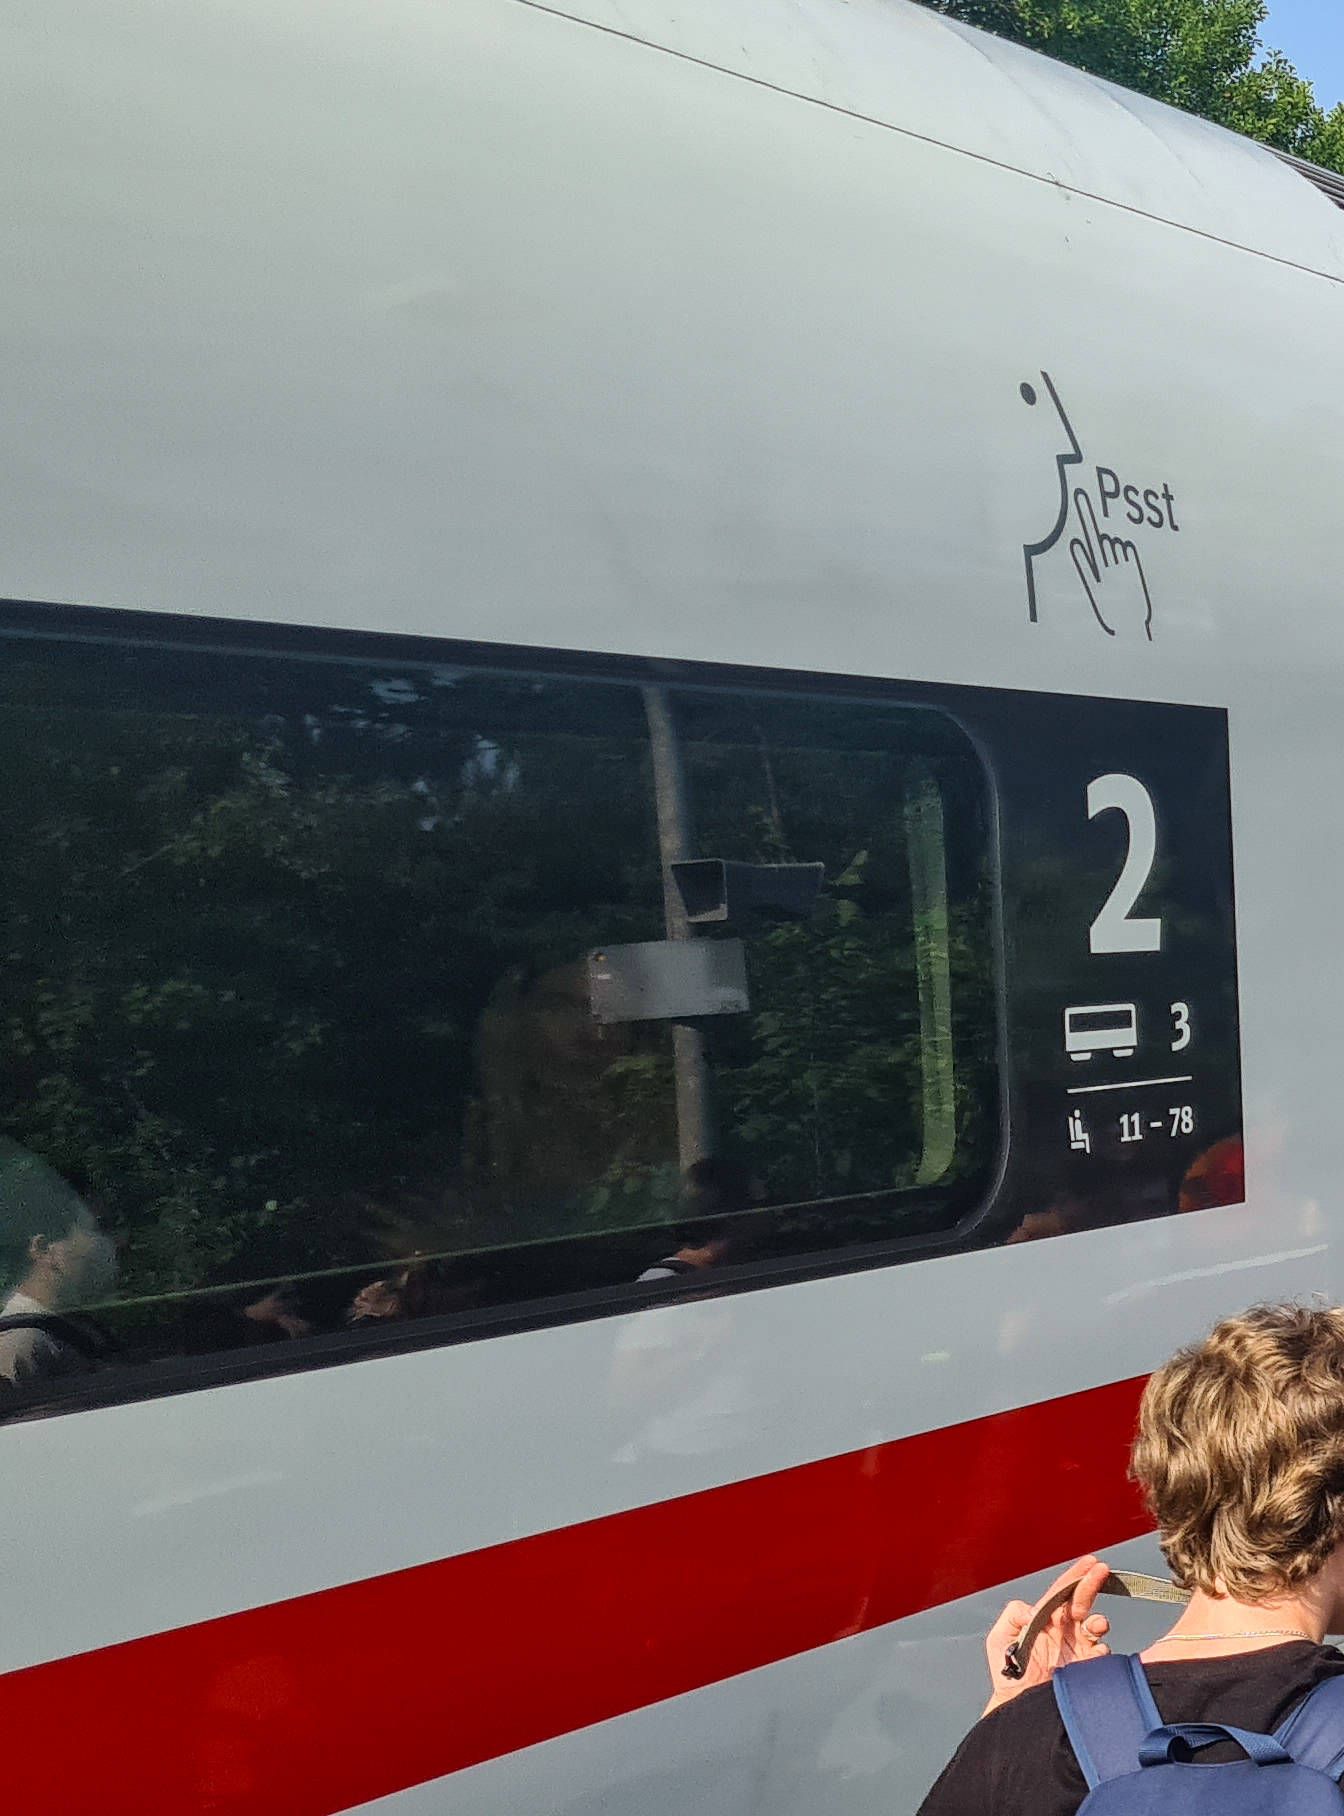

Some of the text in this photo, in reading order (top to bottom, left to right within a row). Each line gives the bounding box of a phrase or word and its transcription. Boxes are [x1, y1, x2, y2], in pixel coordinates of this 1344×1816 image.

[1097, 465, 1179, 532] Psst
[1087, 773, 1162, 954] 2
[1171, 1003, 1191, 1051] 3
[1119, 1112, 1143, 1142] 11
[1169, 1105, 1194, 1137] 78
